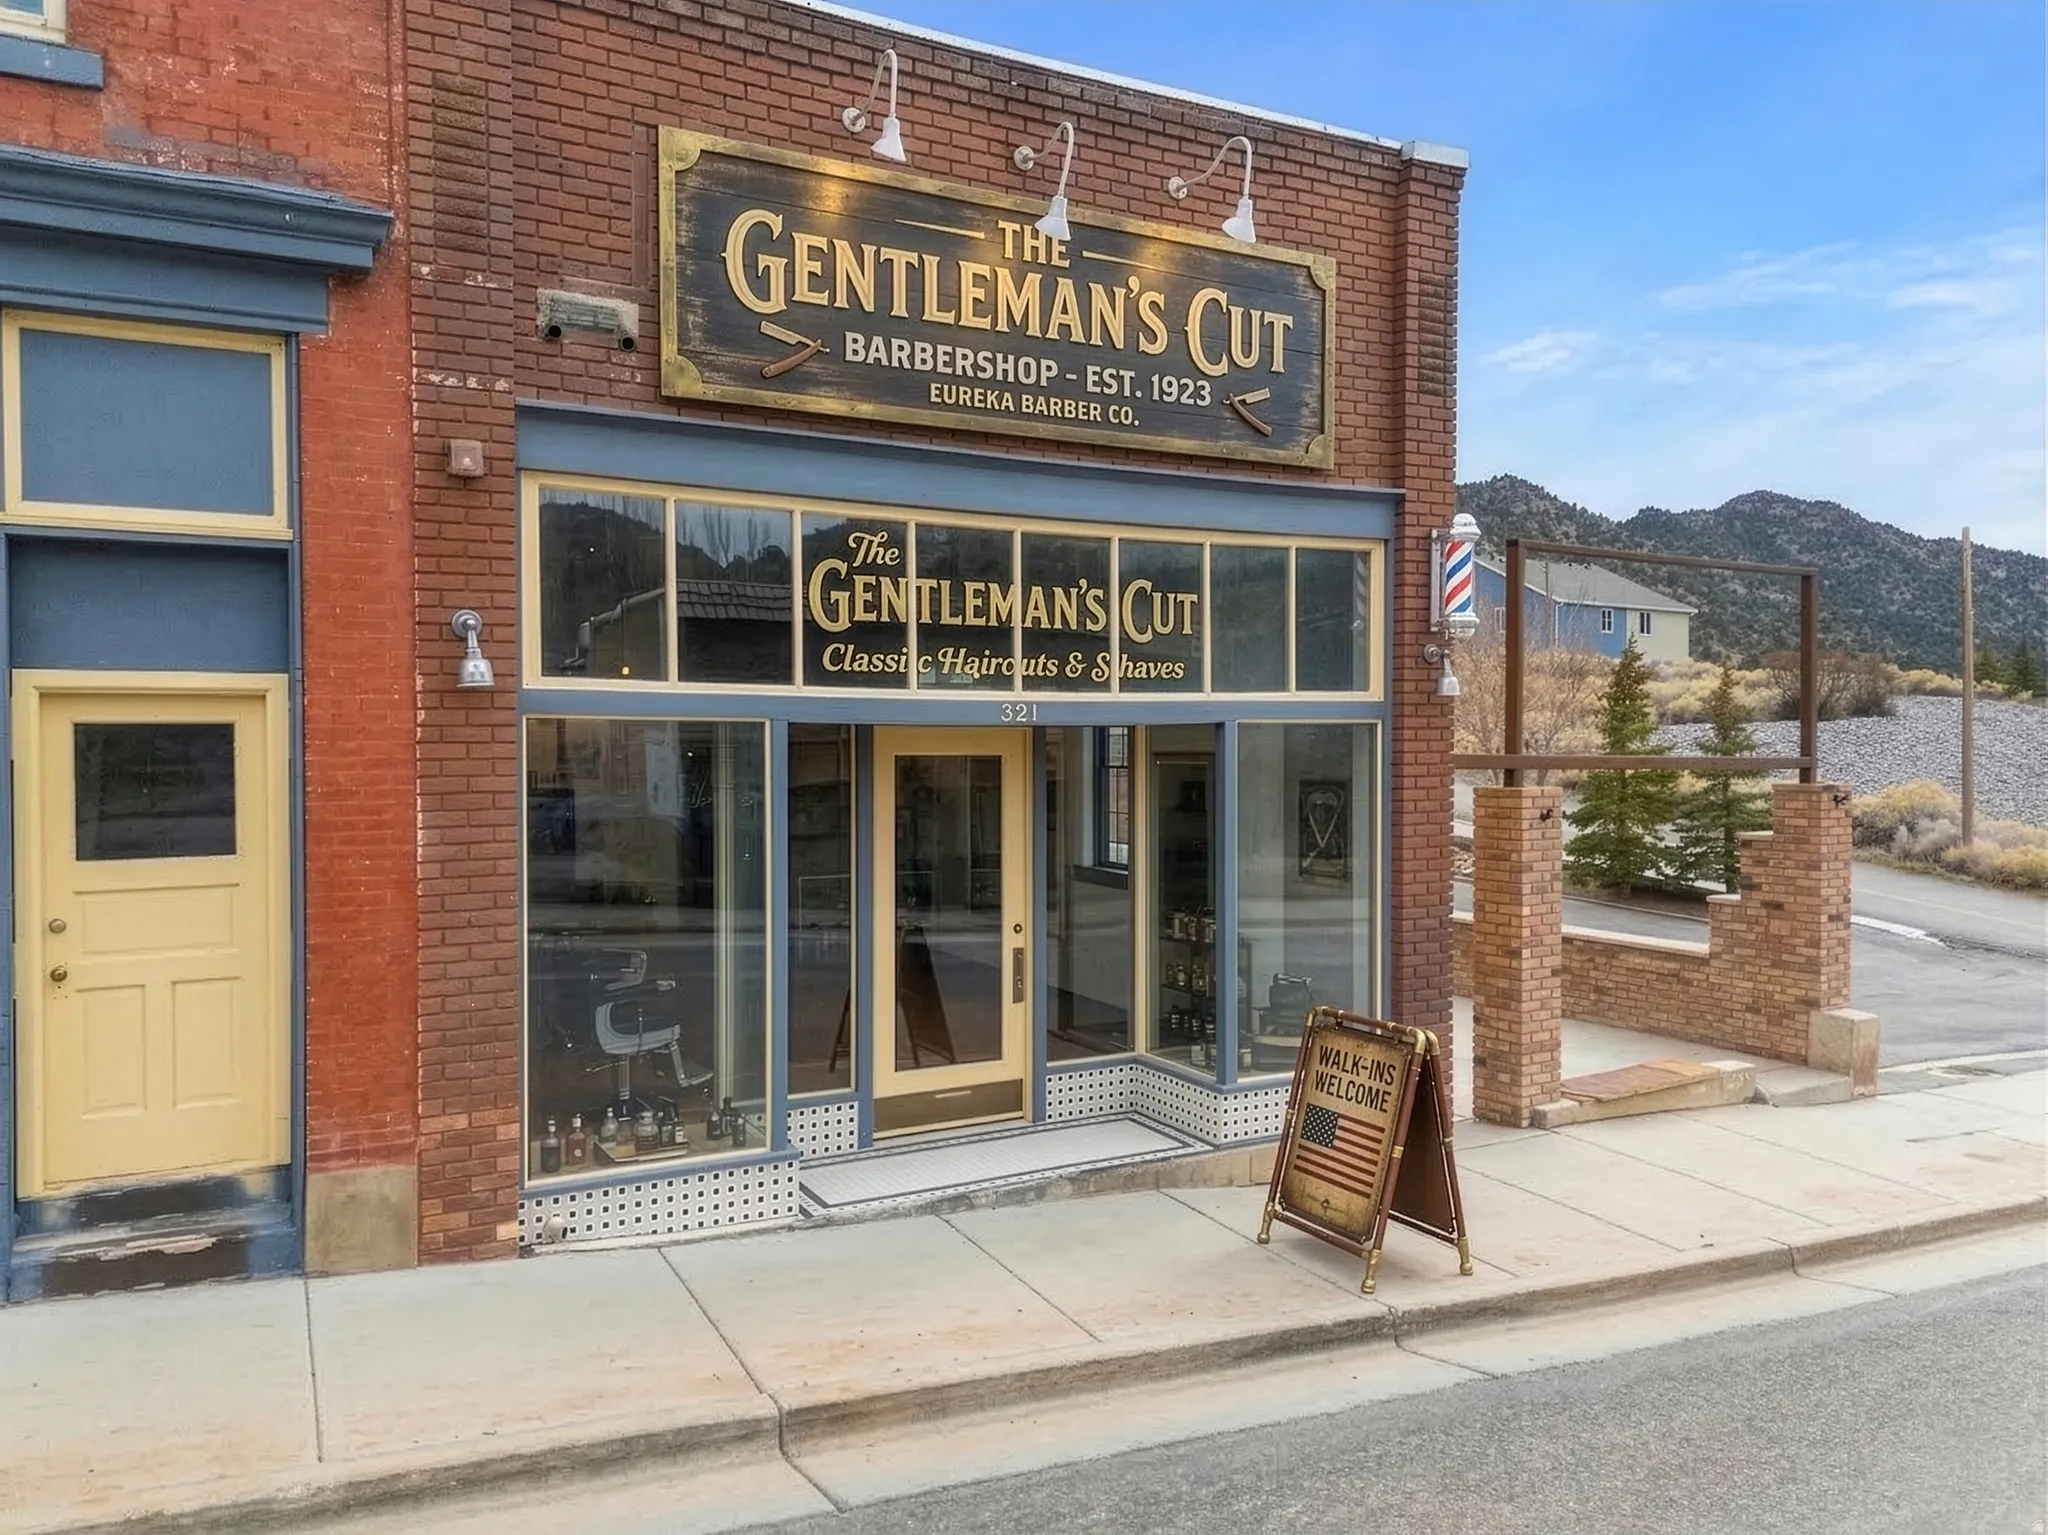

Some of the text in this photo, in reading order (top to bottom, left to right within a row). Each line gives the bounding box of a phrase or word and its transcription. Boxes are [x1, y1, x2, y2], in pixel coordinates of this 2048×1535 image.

[998, 219, 1070, 268] THE
[723, 209, 1293, 377] GENTLEMAN'S CUT
[844, 332, 1058, 387] BARBERSHOP
[1086, 364, 1142, 398] EST.
[1151, 373, 1212, 407] 1923
[929, 382, 1140, 427] EUREKA BARBER CO.
[847, 531, 900, 568] The
[1121, 578, 1198, 644] CUT
[822, 643, 933, 673] Classic
[1064, 652, 1087, 678] &
[1090, 652, 1185, 682] Shaves
[1001, 703, 1037, 721] 321
[1318, 1045, 1396, 1086] WALK-INS
[1315, 1070, 1392, 1113] WELCOME
